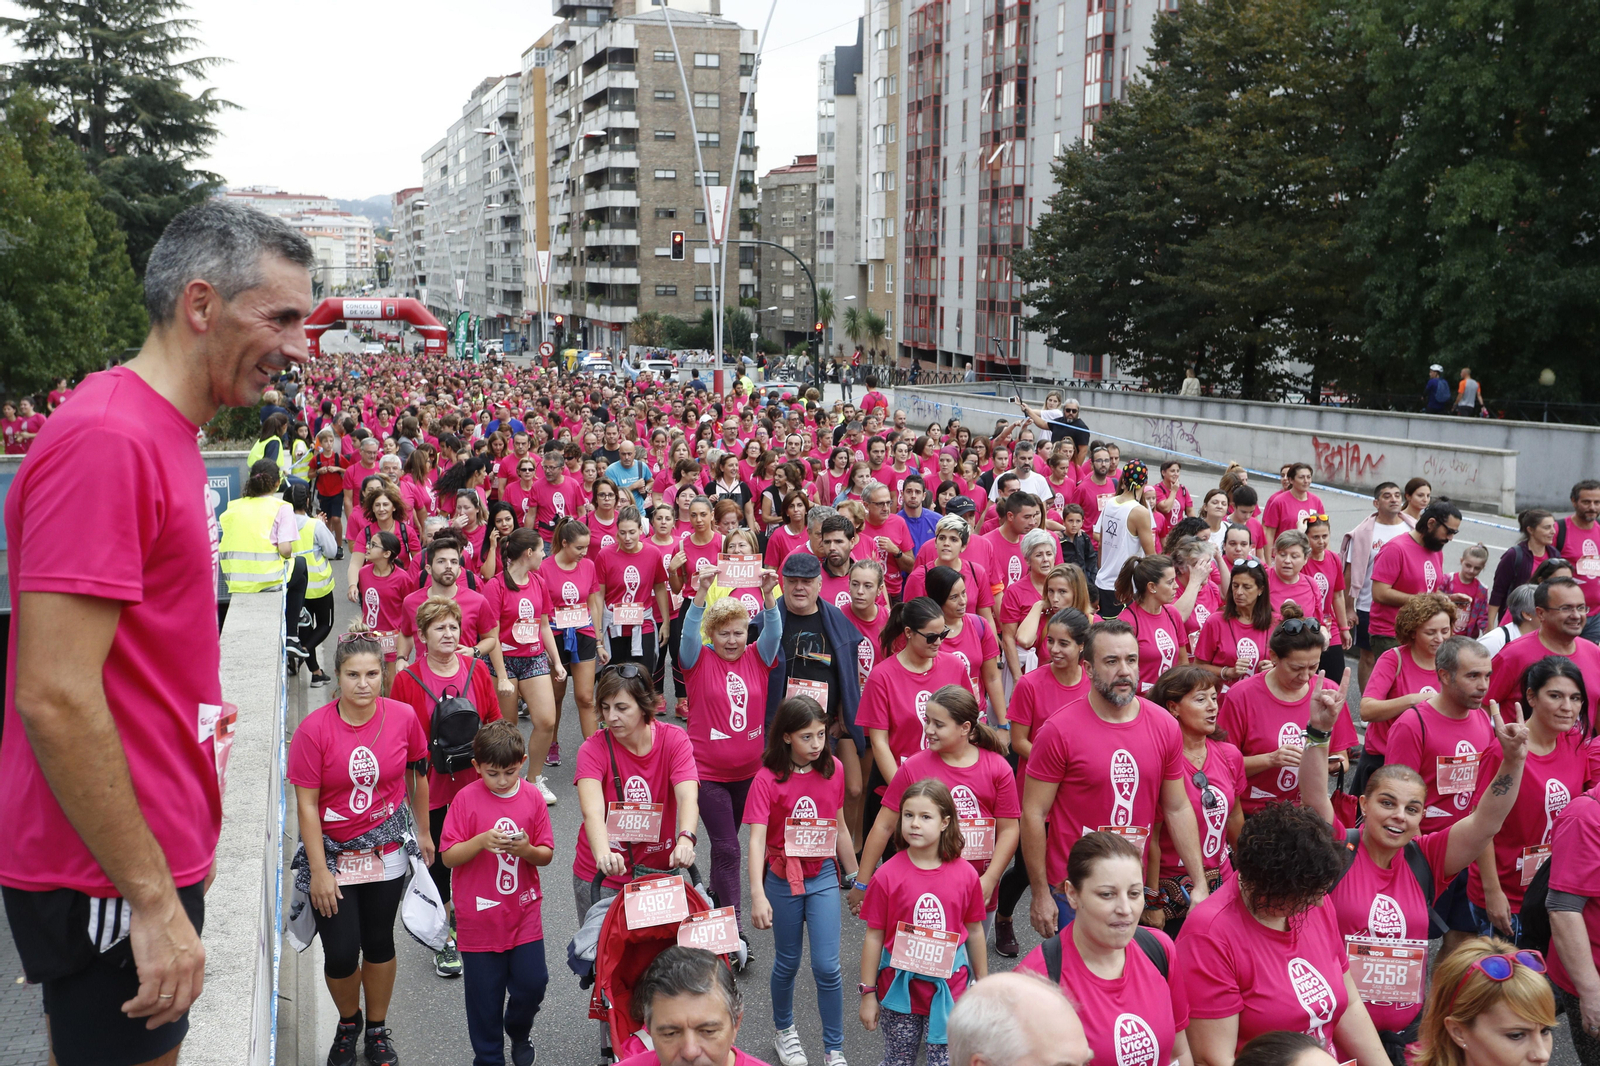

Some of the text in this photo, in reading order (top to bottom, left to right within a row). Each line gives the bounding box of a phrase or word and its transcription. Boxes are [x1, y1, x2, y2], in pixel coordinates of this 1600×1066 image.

[726, 565, 754, 578] 4040
[563, 612, 582, 621] 4747
[620, 610, 638, 618] 4732
[518, 626, 534, 636] 4740
[1450, 767, 1475, 781] 4261
[1550, 784, 1560, 792] VI
[1550, 795, 1566, 804] VIGO
[617, 815, 650, 830] 4884
[795, 830, 827, 845] 5523
[340, 857, 372, 874] 4578
[638, 892, 675, 913] 4982
[923, 898, 933, 907] VI
[1378, 899, 1389, 910] VI
[1376, 912, 1398, 923] VIGO
[690, 923, 727, 944] 4973
[905, 940, 944, 963] 3099
[1292, 964, 1306, 976] VI
[1362, 962, 1408, 985] 2558
[1297, 977, 1319, 992] VIGO
[1121, 1020, 1138, 1034] VI
[1121, 1031, 1146, 1044] EDICIÓN
[1122, 1037, 1151, 1053] VIGO
[1122, 1049, 1146, 1060] CONTRA
